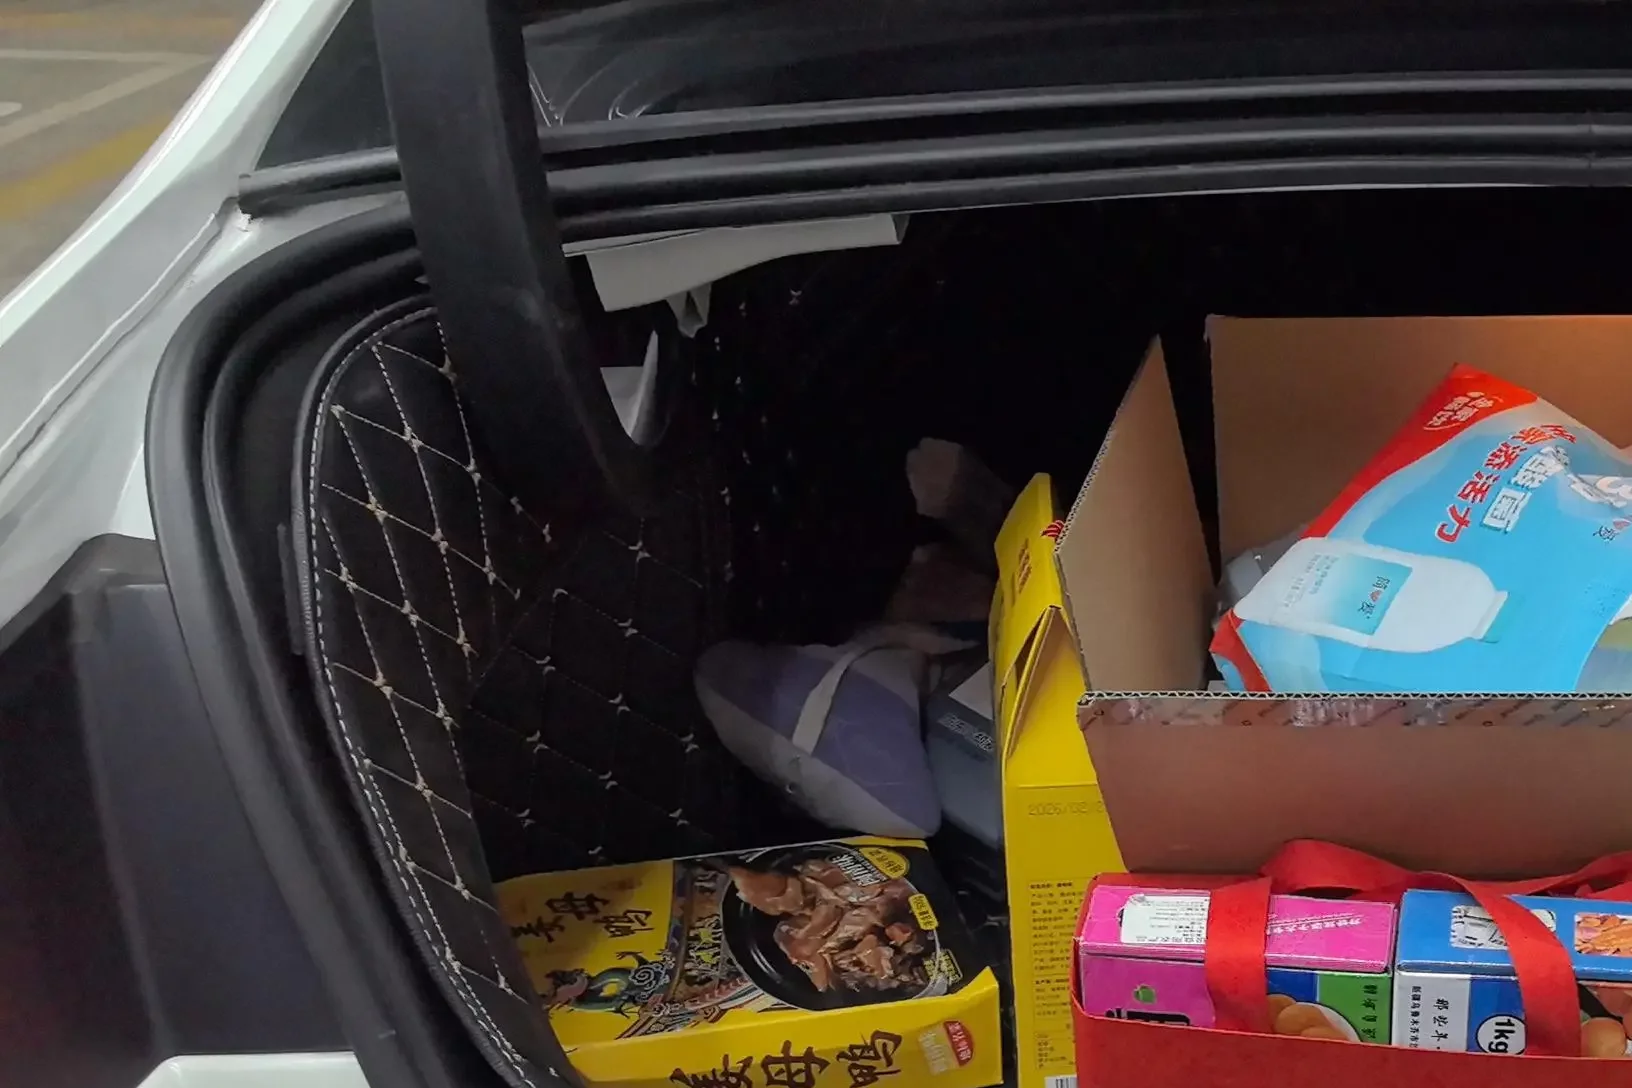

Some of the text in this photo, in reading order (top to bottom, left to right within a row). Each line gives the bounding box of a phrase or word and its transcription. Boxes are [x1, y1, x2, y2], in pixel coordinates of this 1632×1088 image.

[509, 891, 655, 943] 姜母鸭
[1488, 1018, 1516, 1054] 1kg
